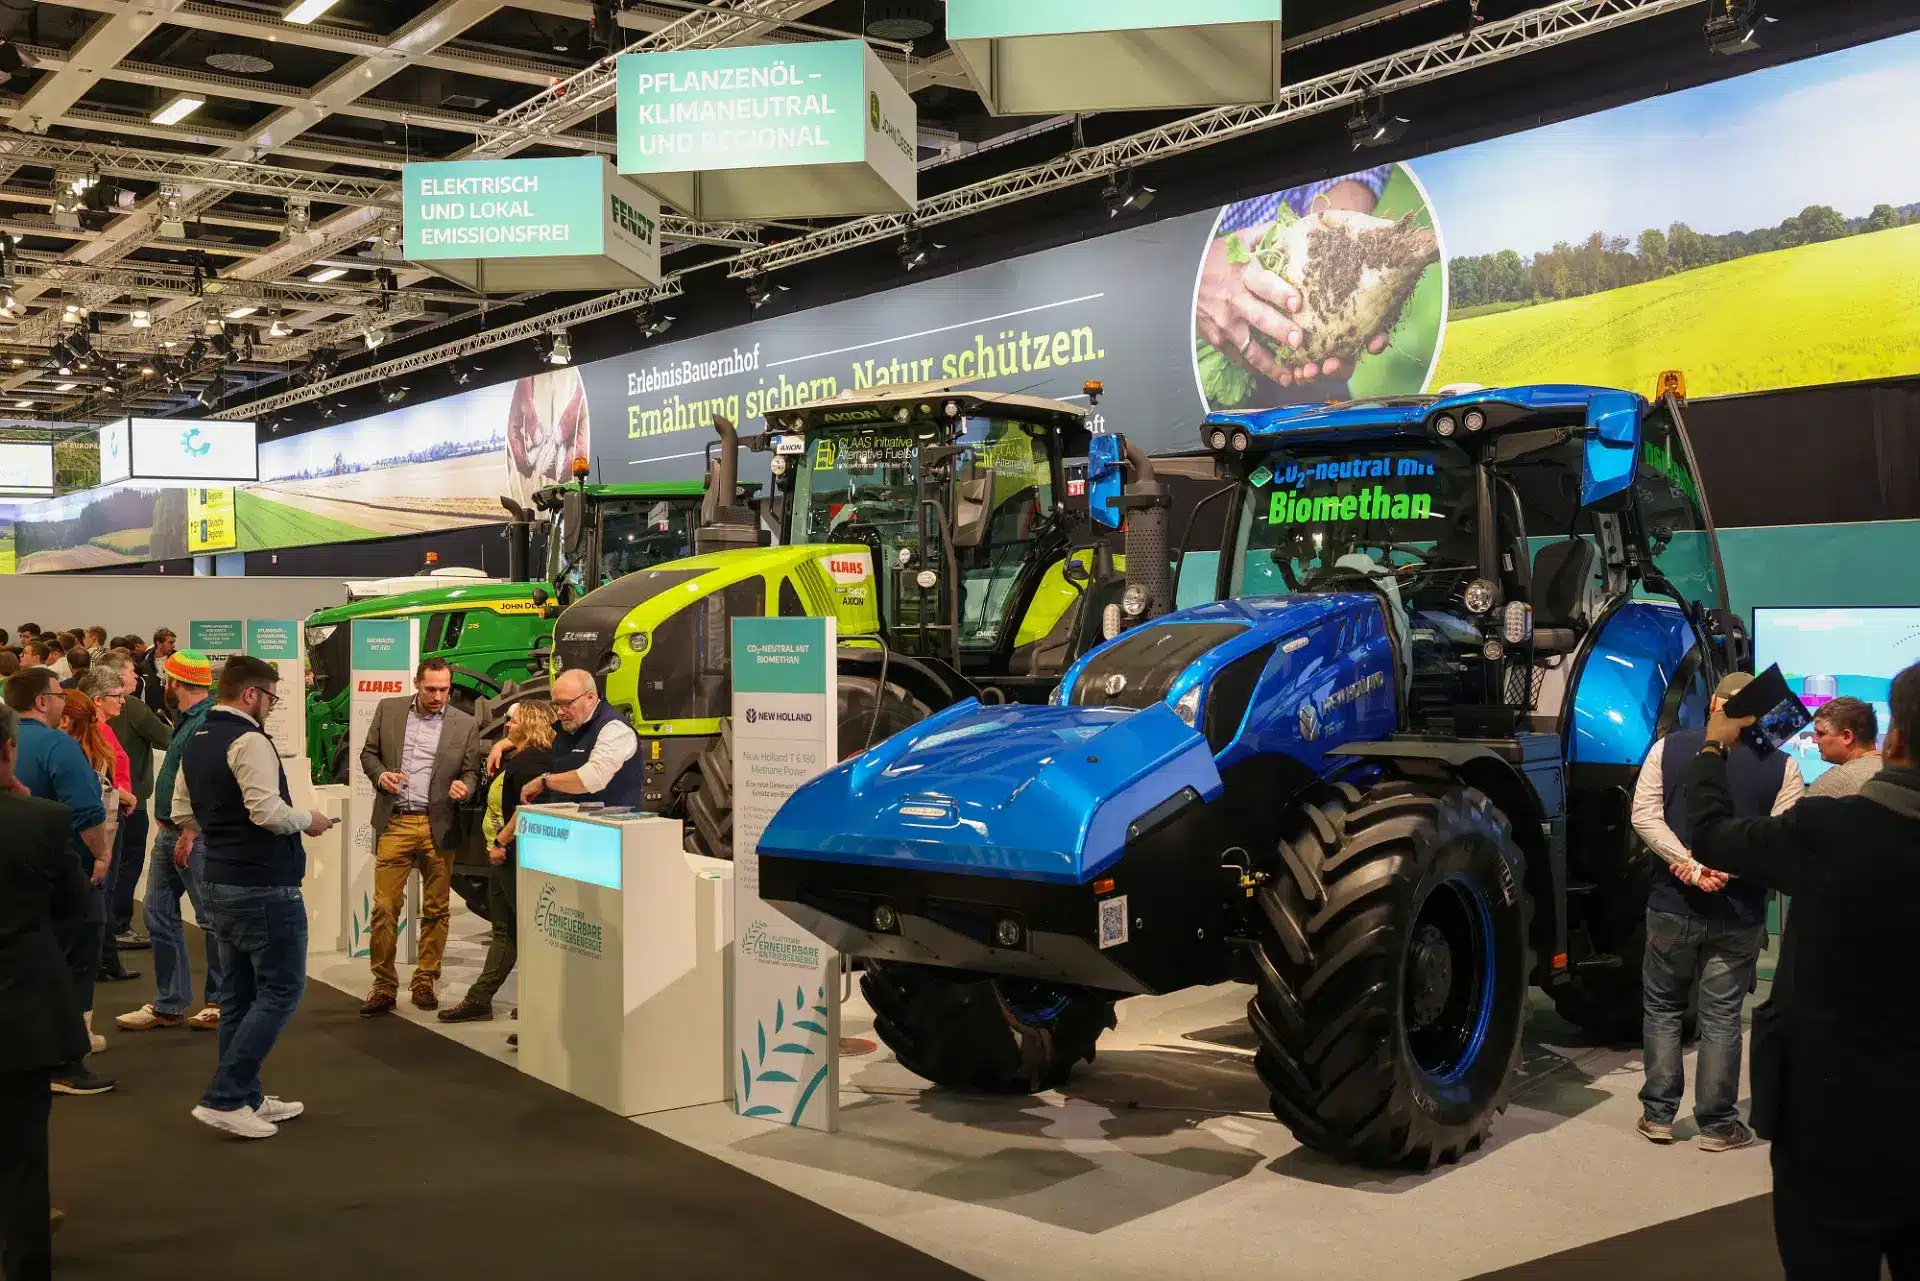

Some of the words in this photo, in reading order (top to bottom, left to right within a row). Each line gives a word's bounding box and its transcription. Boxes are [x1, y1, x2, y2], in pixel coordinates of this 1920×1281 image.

[638, 60, 804, 94] PFLANZENÖL
[639, 93, 836, 124] KLIMANEUTRAL
[640, 132, 692, 156] UND
[420, 176, 539, 196] ELEKTRISCH
[420, 203, 465, 221] UND
[469, 200, 535, 220] LOKAL
[611, 193, 656, 246] FENDT
[421, 224, 569, 245] EMISSIONSFREI
[627, 342, 760, 396] ErlebnisBauernhof
[628, 393, 740, 440] Ernährung
[853, 356, 933, 391] Natur
[942, 324, 1106, 381] schützen.
[824, 409, 880, 422] AXION
[839, 437, 872, 449] CLAAS
[837, 447, 883, 460] Alternative
[1269, 486, 1432, 524] Biomethan
[830, 560, 863, 574] CLAAS
[500, 602, 523, 610] JOHN
[842, 597, 864, 606] AXION
[796, 645, 809, 653] MIT
[757, 656, 799, 664] BIOMETHAN
[358, 680, 402, 692] CLAAS
[758, 712, 776, 720] NEW
[776, 713, 812, 721] HOLLAND
[743, 752, 759, 760] New
[760, 752, 788, 762] Holland
[751, 765, 782, 775] Methane
[784, 766, 807, 776] Power
[528, 823, 542, 834] NEW
[542, 825, 569, 840] HOLLAND
[559, 905, 585, 919] PLATTFORM
[548, 912, 602, 940] ERNEUERBARE
[548, 927, 602, 953] ANTRIEBSENERGIE
[772, 935, 800, 944] PLATTFORM
[758, 941, 820, 957] ERNEUERBARE
[758, 950, 820, 966] ANTRIEBSENERGIE
